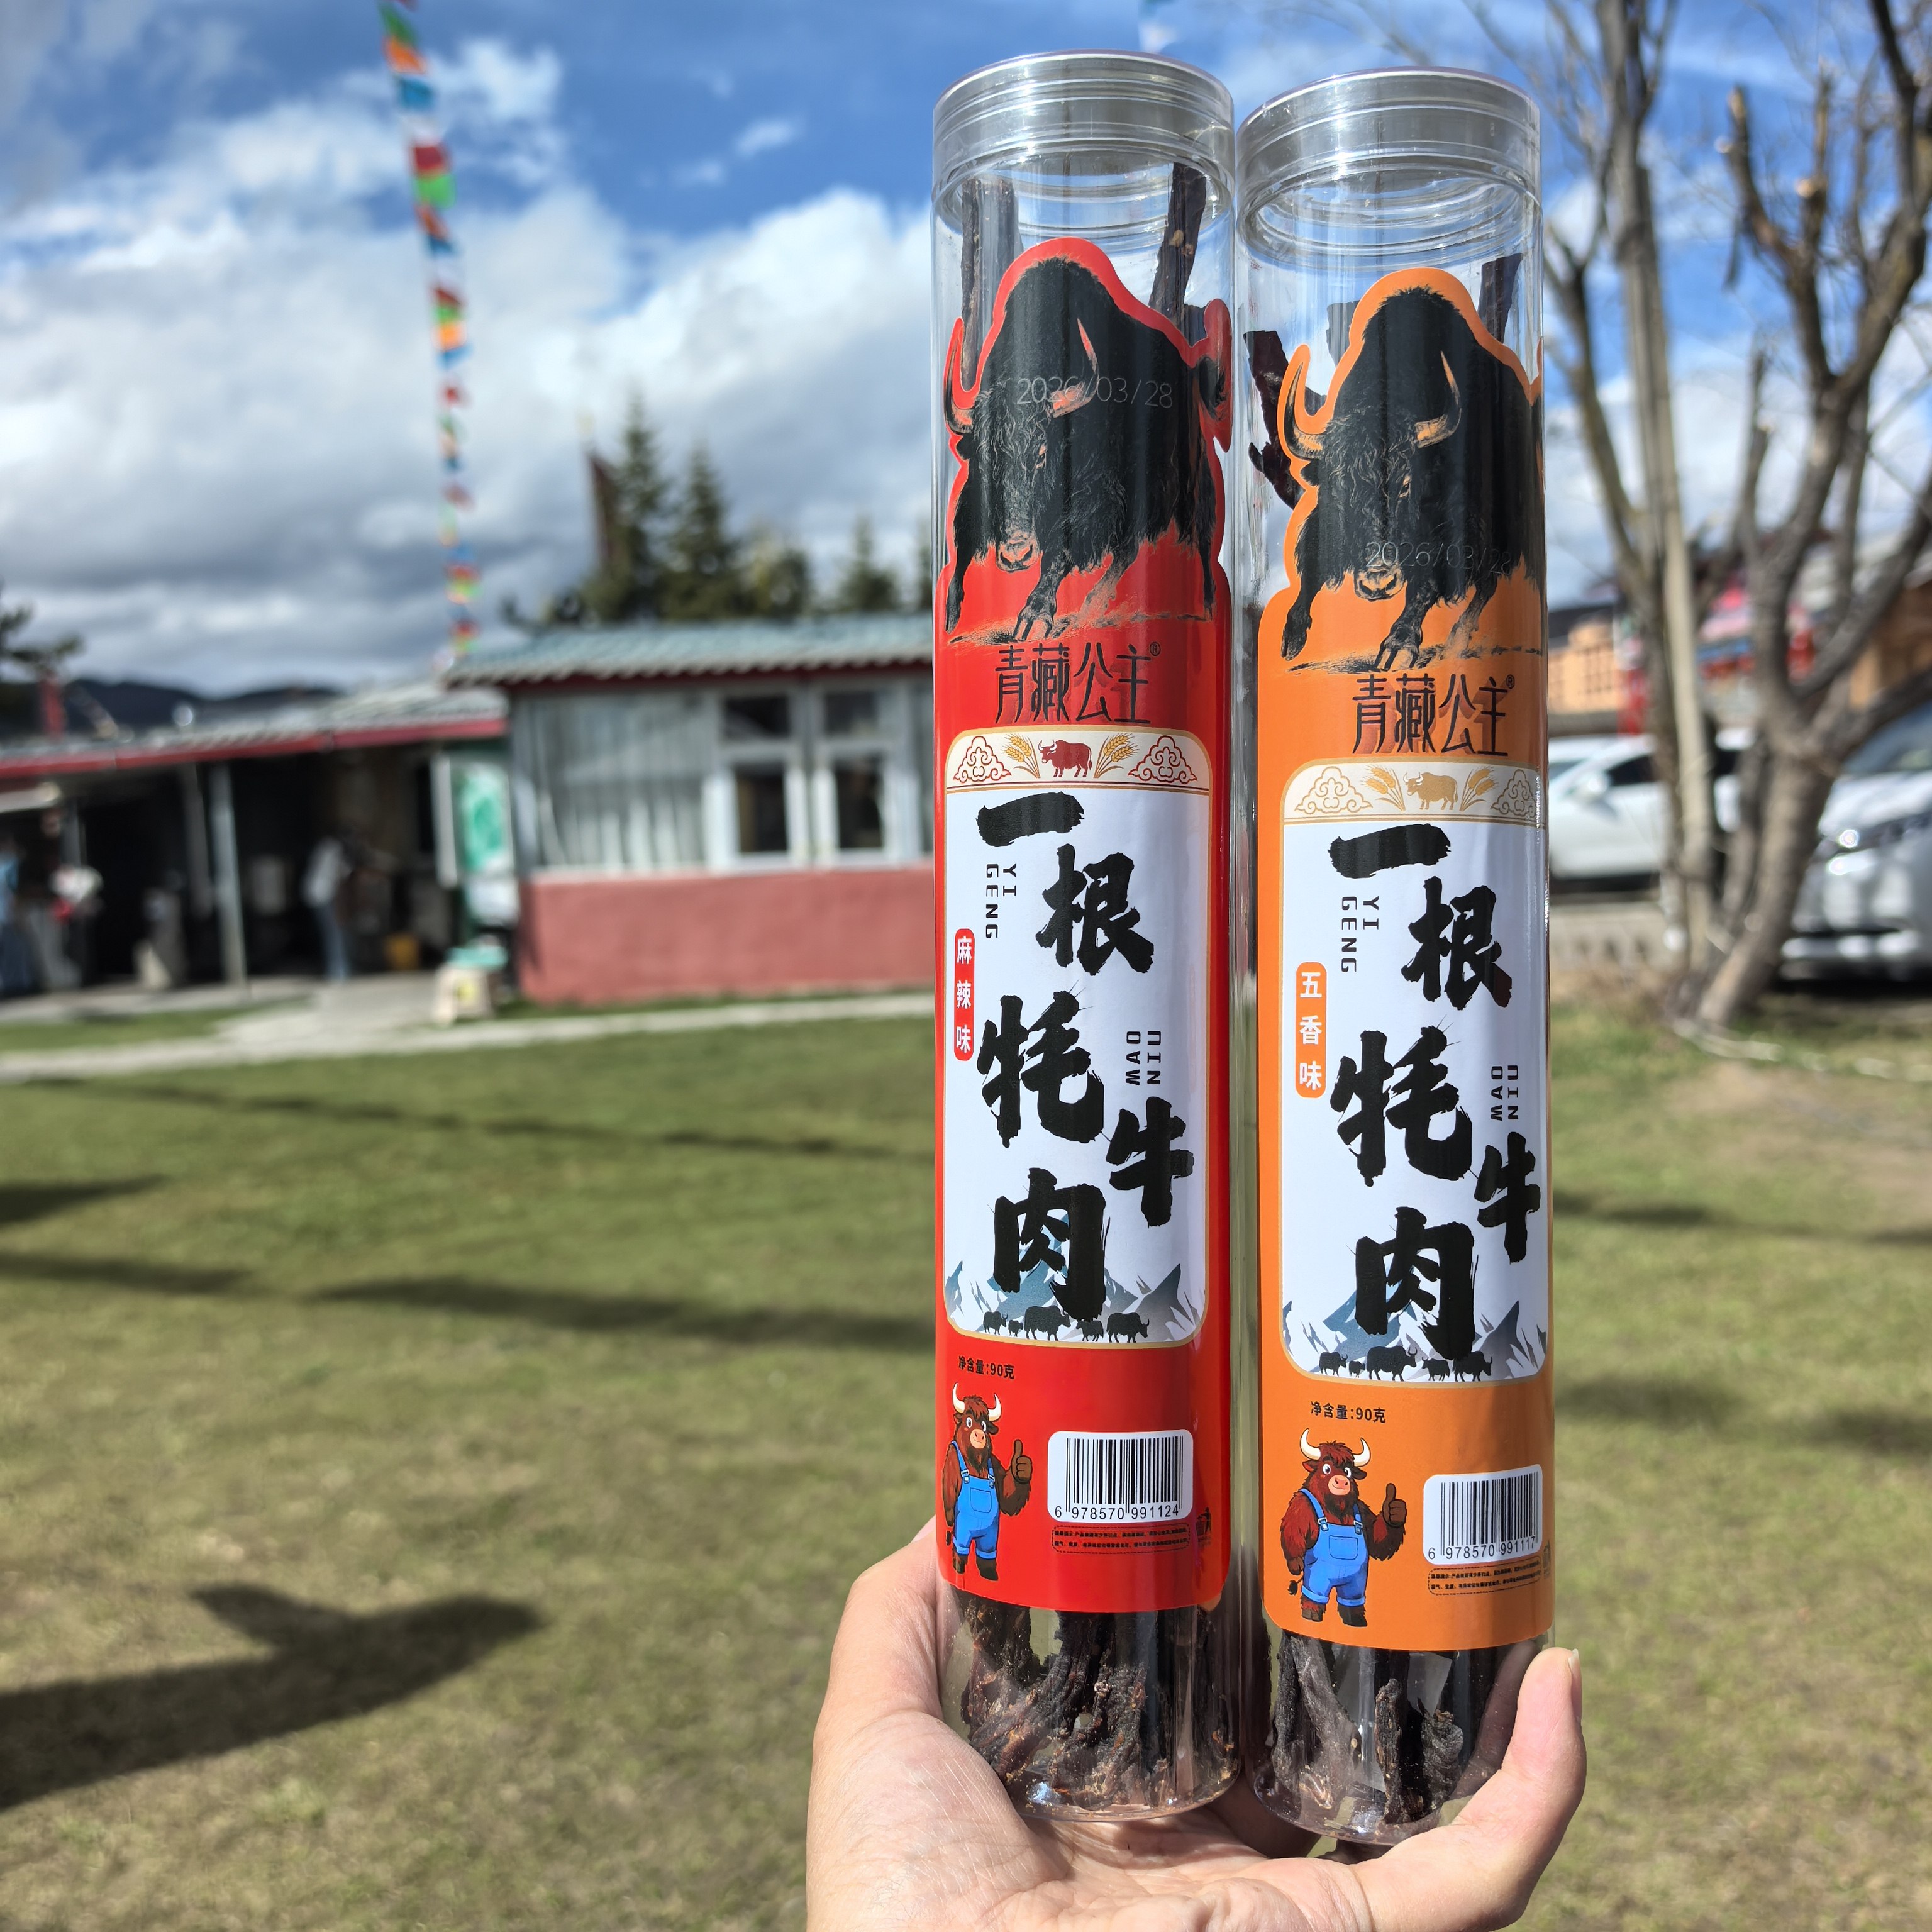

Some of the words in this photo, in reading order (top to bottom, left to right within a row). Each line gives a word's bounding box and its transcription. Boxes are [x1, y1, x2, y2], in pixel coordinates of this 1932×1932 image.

[1017, 375, 1173, 409] 2026/03/28
[995, 642, 1152, 723] 青藏公主
[1352, 673, 1509, 756] 青藏公主
[985, 863, 999, 938] GENG
[1002, 863, 1017, 897] YI
[1341, 896, 1357, 972] GENG
[1363, 896, 1379, 930] YI
[956, 935, 972, 1054] 麻辣味
[1125, 1031, 1141, 1085] MAO
[1146, 1030, 1162, 1085] NIU
[1299, 972, 1323, 1091] 五香味
[1491, 1065, 1503, 1121] MAO
[1507, 1065, 1519, 1120] NIU
[1055, 1506, 1062, 1518] 6
[1072, 1506, 1125, 1520] 978570
[1131, 1503, 1179, 1519] 991124
[1428, 1547, 1436, 1560] 6
[1445, 1543, 1495, 1559] 978570
[1501, 1536, 1536, 1555] 991117
